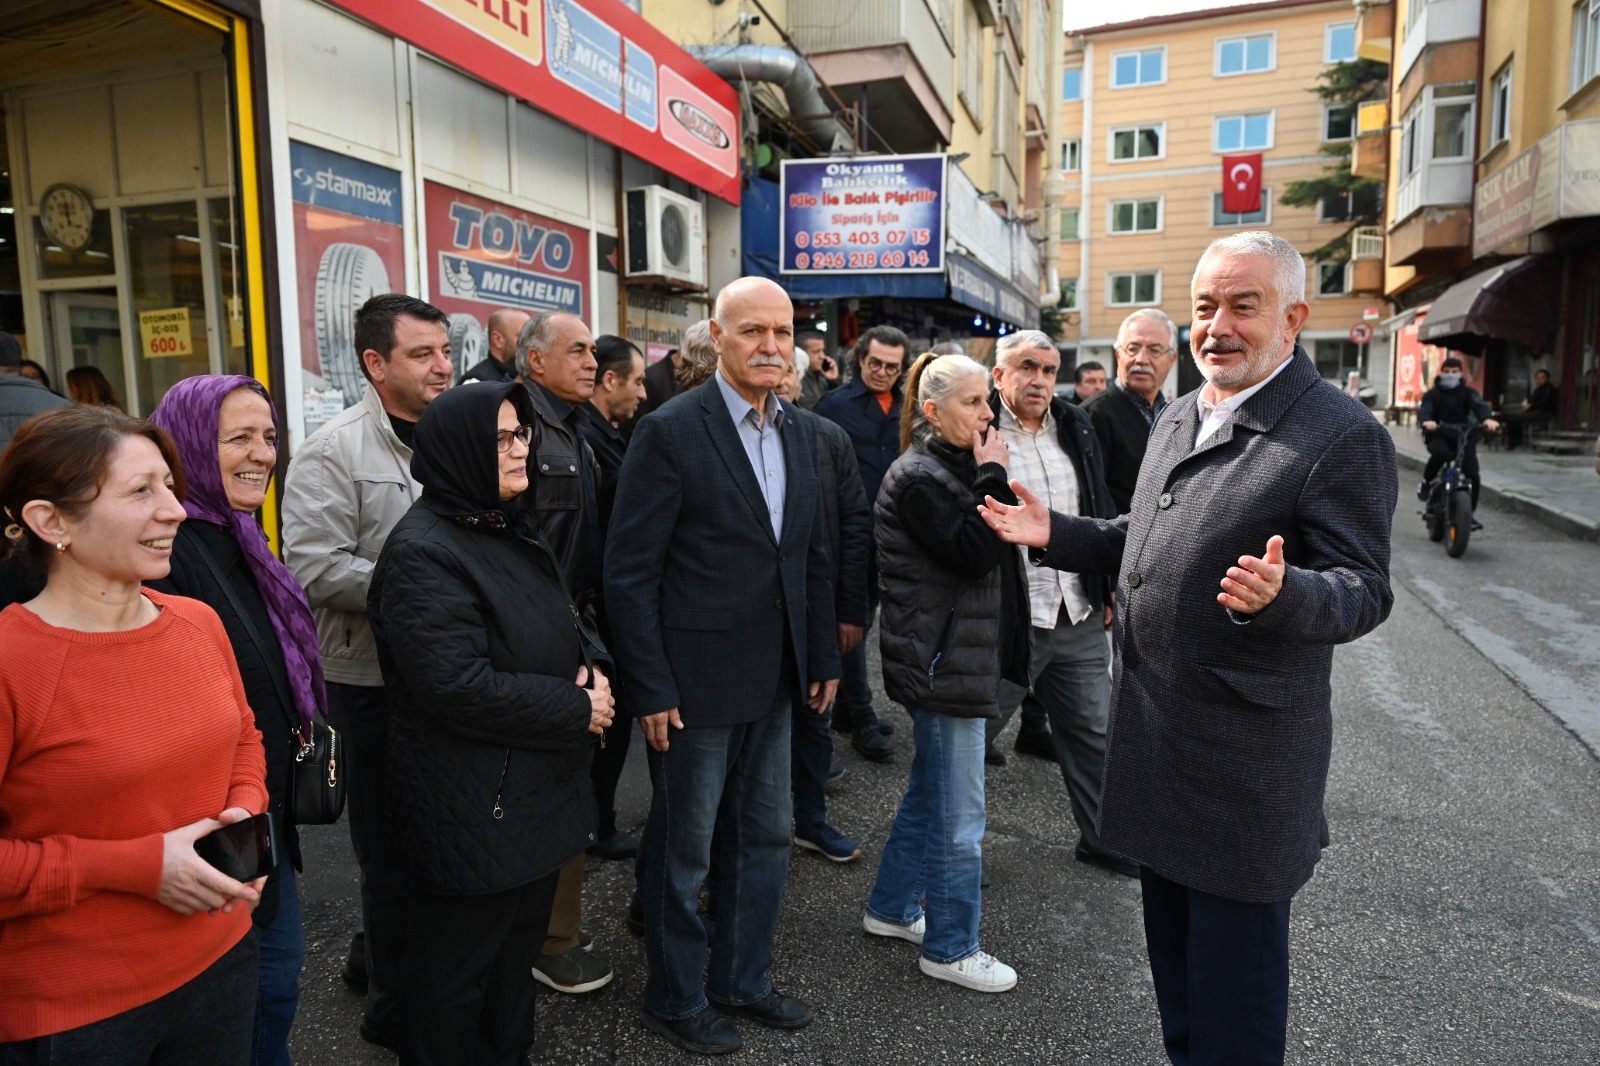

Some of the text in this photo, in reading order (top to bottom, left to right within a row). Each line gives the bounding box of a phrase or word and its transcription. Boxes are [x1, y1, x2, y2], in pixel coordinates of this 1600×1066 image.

[826, 163, 904, 176] Okyanus
[315, 167, 392, 206] starmaxx
[790, 193, 817, 207] Kilo
[831, 210, 899, 226] Sipariş İçin
[450, 202, 573, 273] TOYO
[796, 228, 931, 248] 0 553 403 07 15
[796, 249, 929, 269] 0 246 218 60 14
[481, 270, 575, 306] MICHELIN
[142, 312, 186, 325] OTOMOBİL
[150, 336, 177, 354] 600
